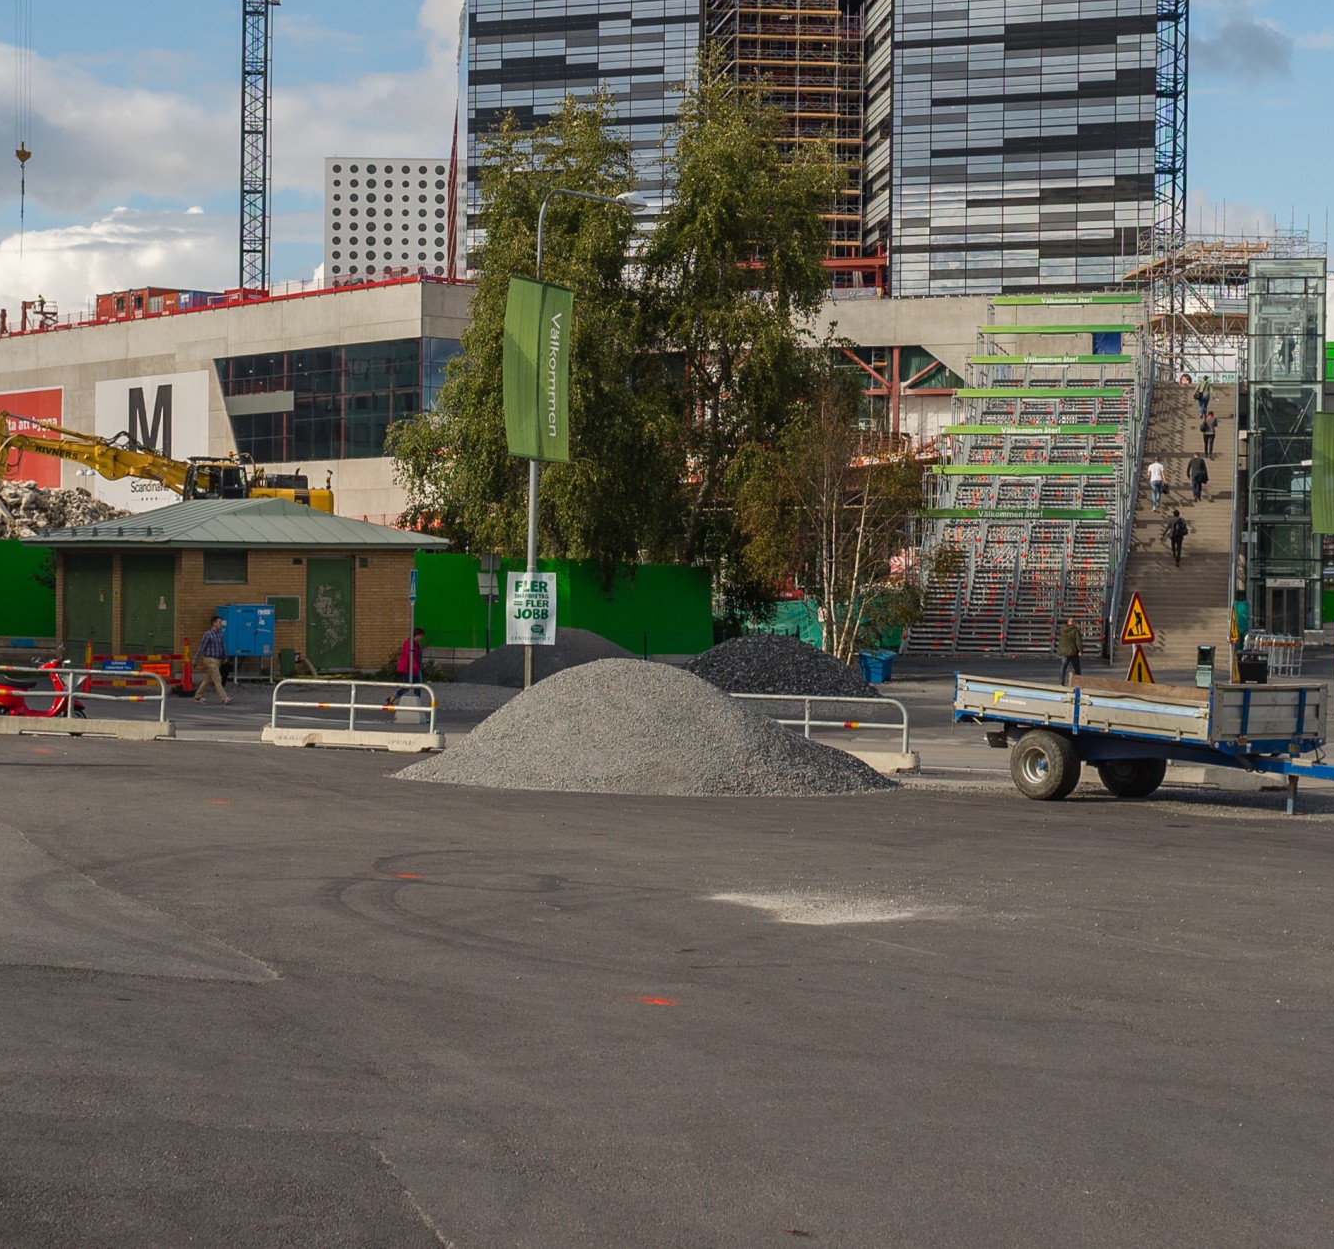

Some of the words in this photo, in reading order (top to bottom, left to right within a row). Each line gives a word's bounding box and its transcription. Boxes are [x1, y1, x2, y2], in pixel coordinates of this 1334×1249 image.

[1062, 355, 1079, 363] åter!
[548, 312, 562, 437] Välkommen
[129, 384, 172, 460] M
[1001, 426, 1043, 434] Välkommen
[1044, 426, 1061, 434] åter!
[977, 510, 1023, 518] Välkommen
[1024, 509, 1043, 518] åter!
[514, 580, 549, 593] FLER
[525, 599, 549, 608] FLER
[513, 608, 549, 620] JOBB
